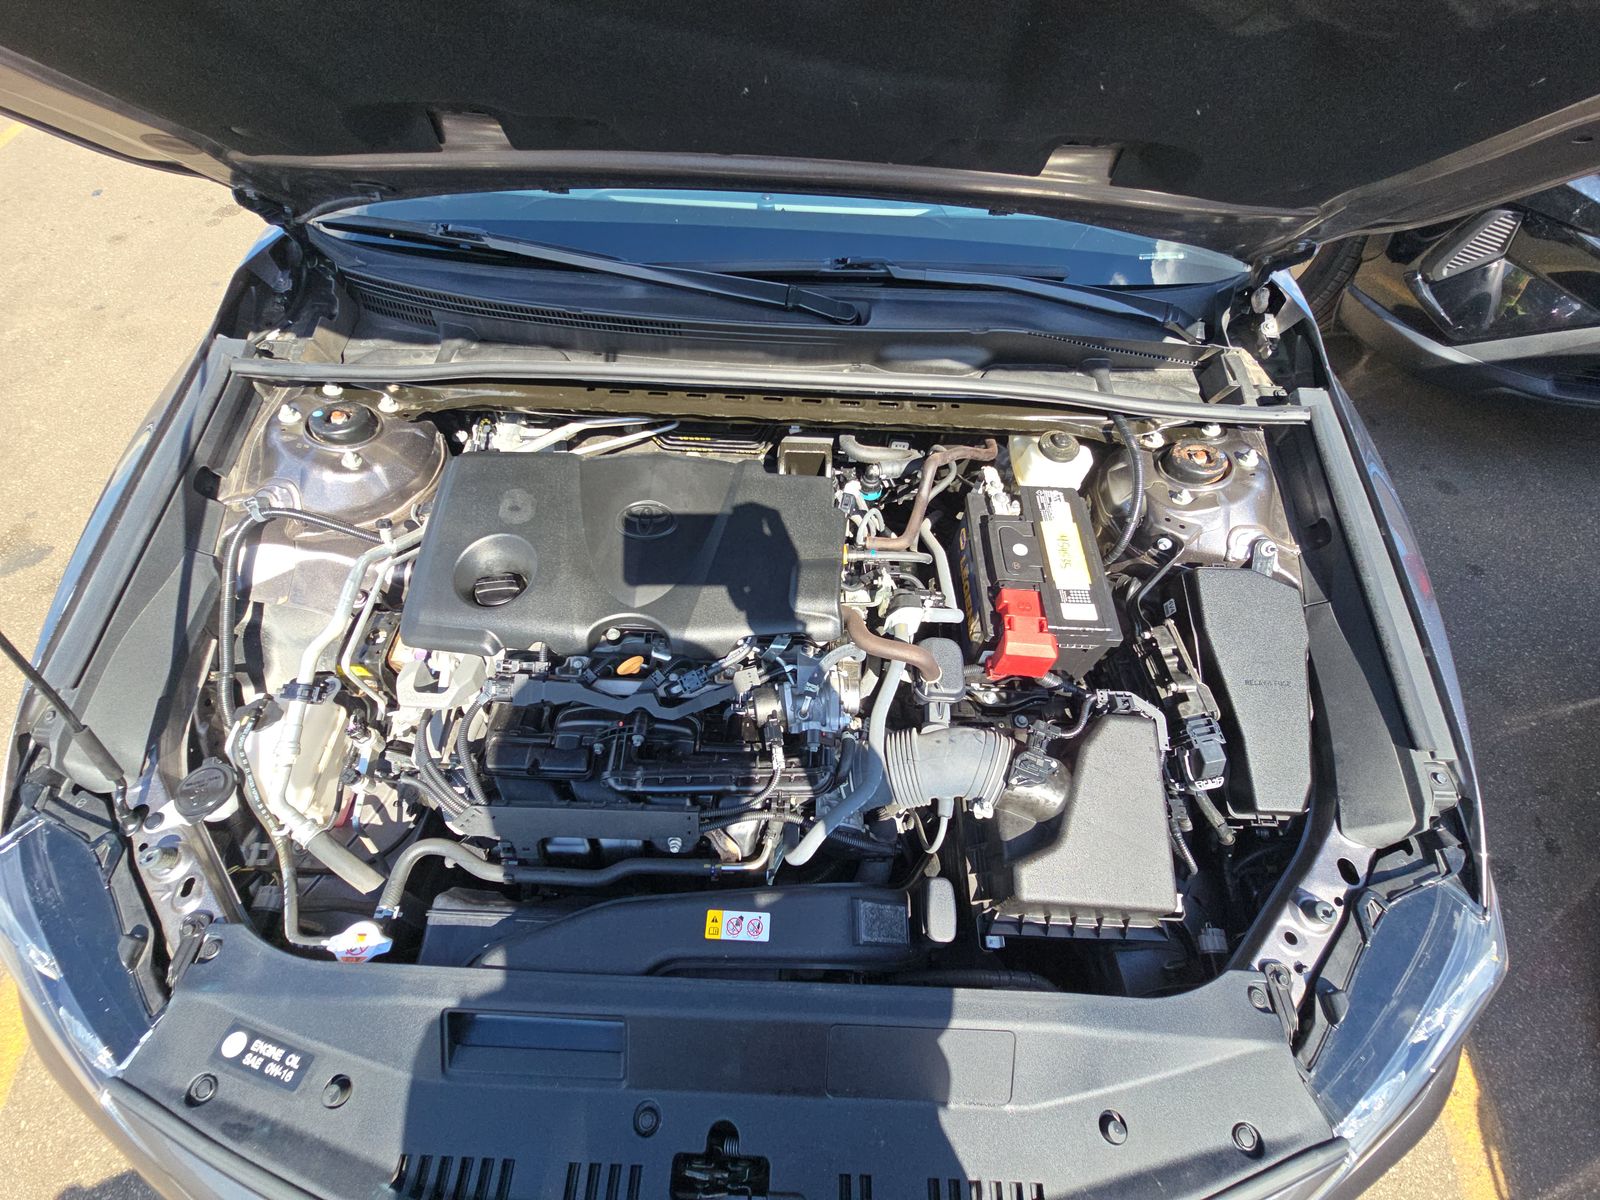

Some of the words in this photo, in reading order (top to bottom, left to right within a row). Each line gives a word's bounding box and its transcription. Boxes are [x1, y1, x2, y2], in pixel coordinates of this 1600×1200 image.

[242, 1052, 264, 1070] SAE
[250, 1039, 285, 1062] ENGINE
[285, 1053, 301, 1070] OIL
